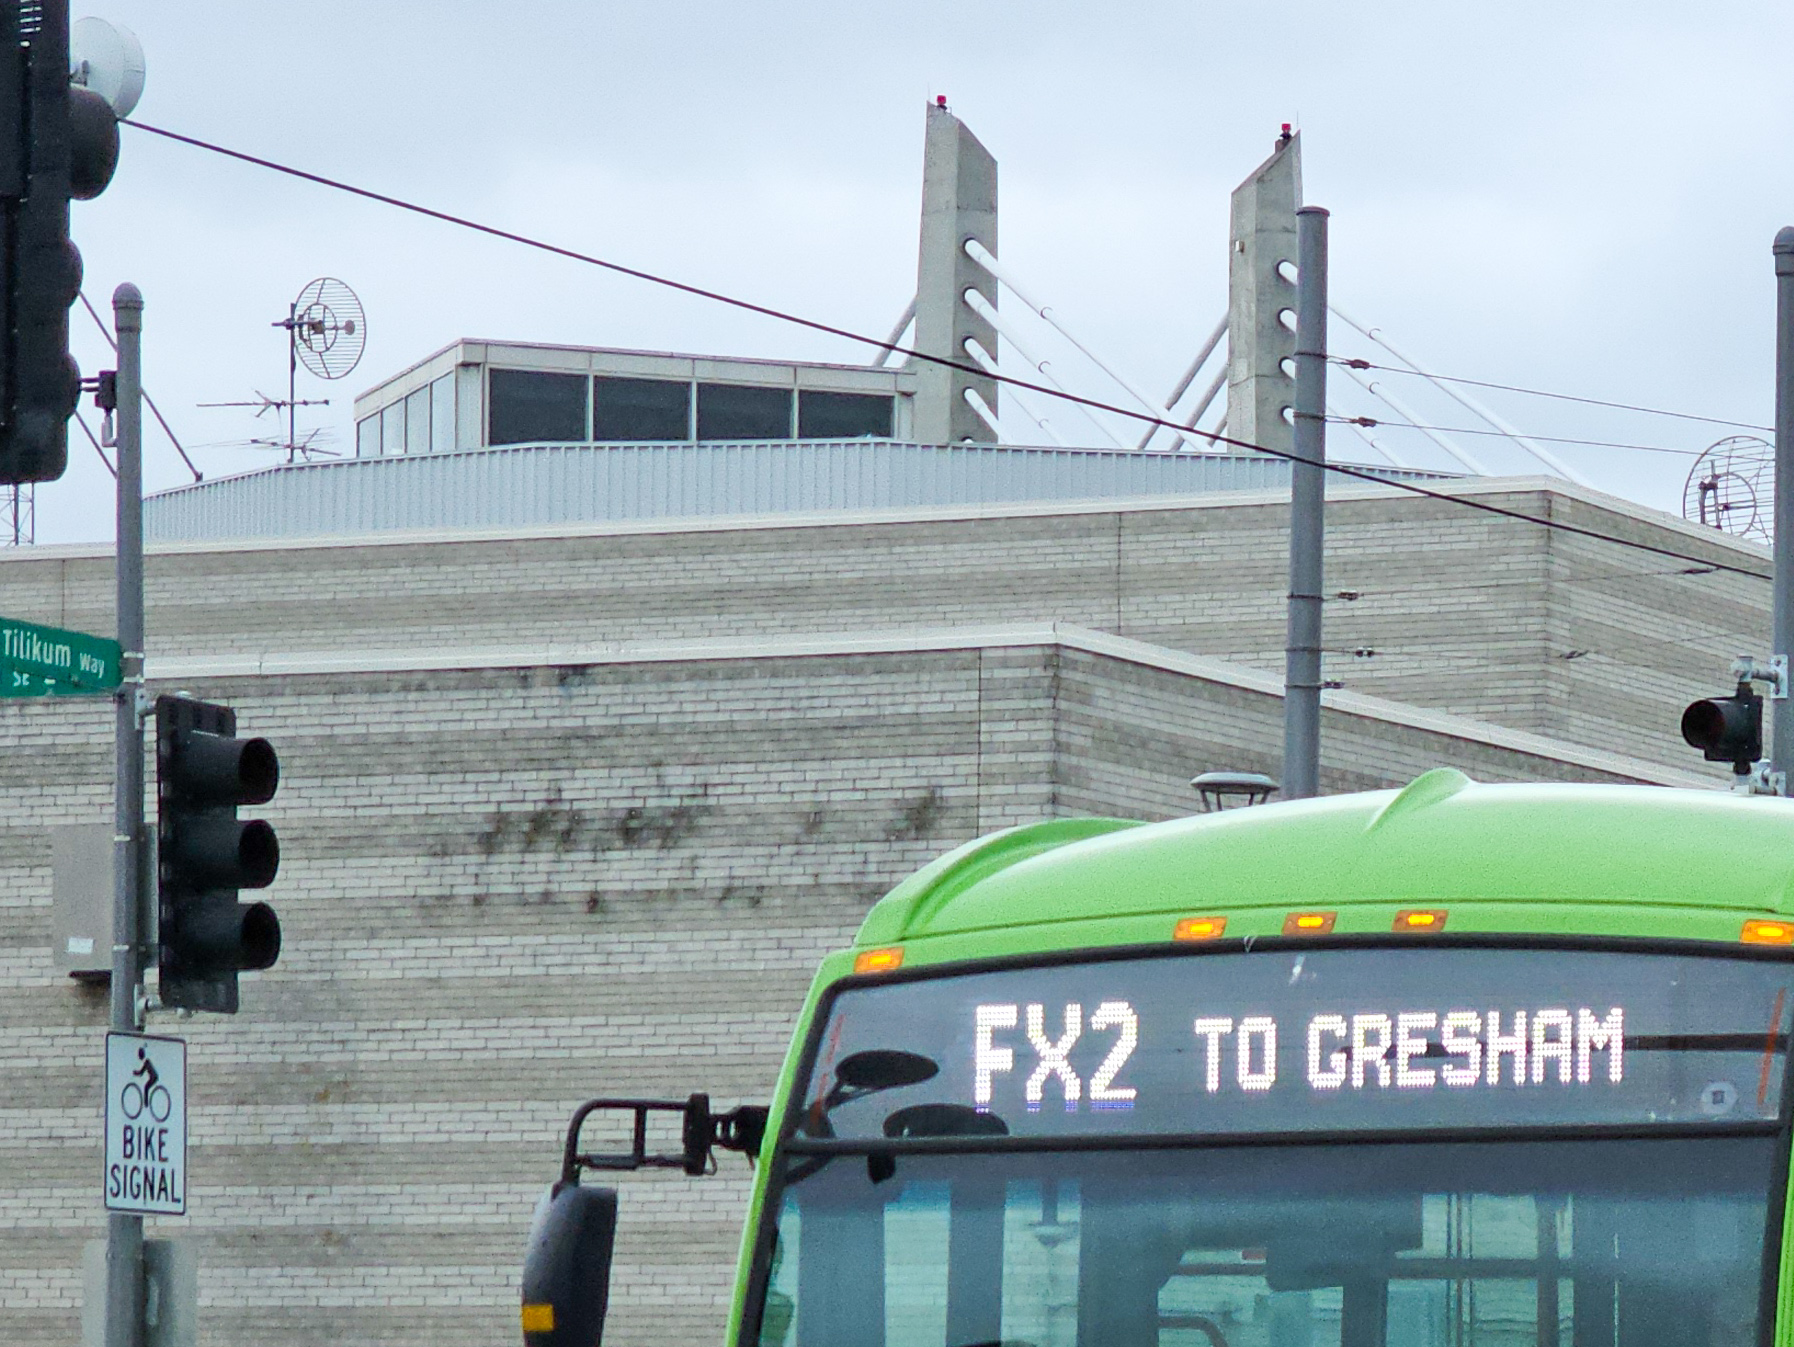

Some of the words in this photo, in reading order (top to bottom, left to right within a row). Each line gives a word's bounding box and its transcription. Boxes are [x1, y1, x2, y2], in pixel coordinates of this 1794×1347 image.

[3, 629, 71, 667] Tilikum
[80, 652, 105, 678] Way
[974, 1001, 1138, 1113] FX2
[1195, 1015, 1277, 1092] TO
[1307, 1007, 1624, 1091] GRESHAM
[123, 1125, 169, 1162] BIKE
[110, 1164, 181, 1203] SIGNAL
